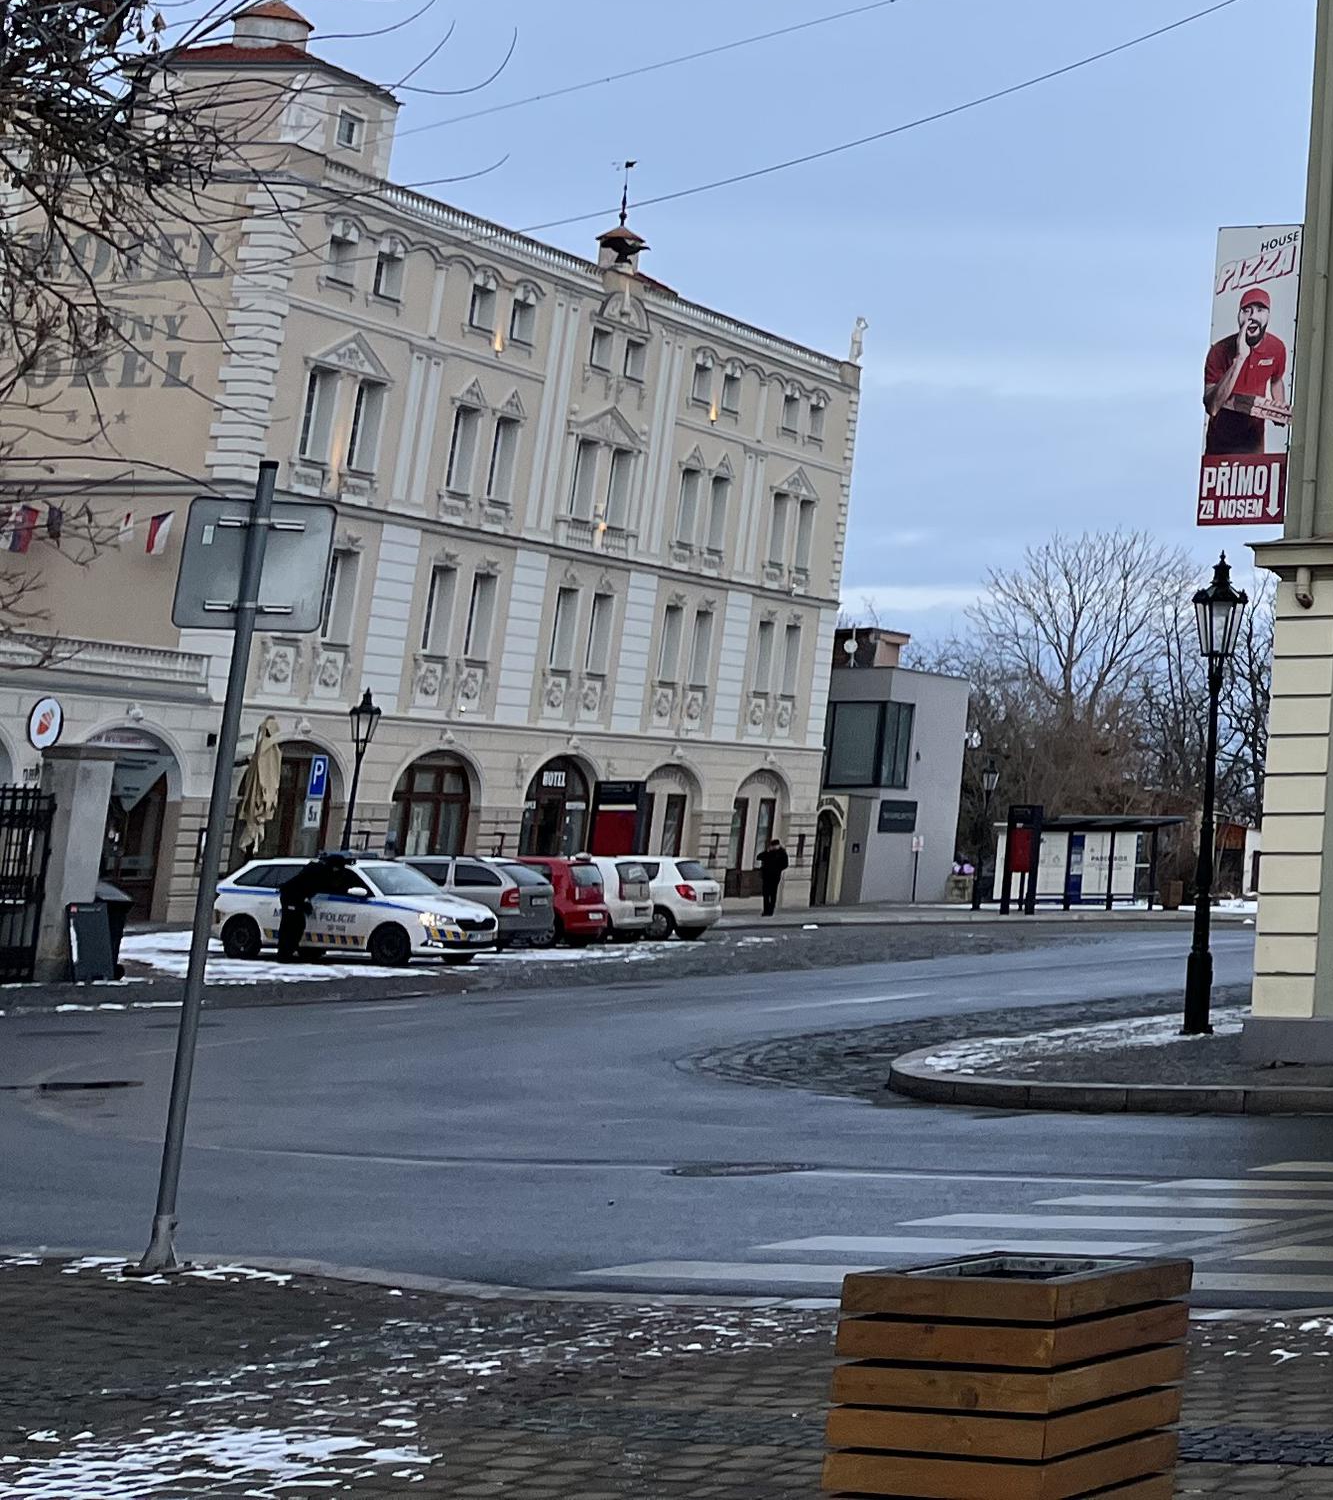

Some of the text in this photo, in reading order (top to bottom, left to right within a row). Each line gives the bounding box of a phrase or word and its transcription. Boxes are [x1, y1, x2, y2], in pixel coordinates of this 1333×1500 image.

[1260, 230, 1300, 252] HOUSE
[1216, 244, 1297, 296] PIZZA
[1201, 461, 1269, 497] PŘÍMO
[1199, 498, 1264, 519] ZA NOSEM
[313, 760, 324, 785] P
[542, 771, 566, 787] HOTEL
